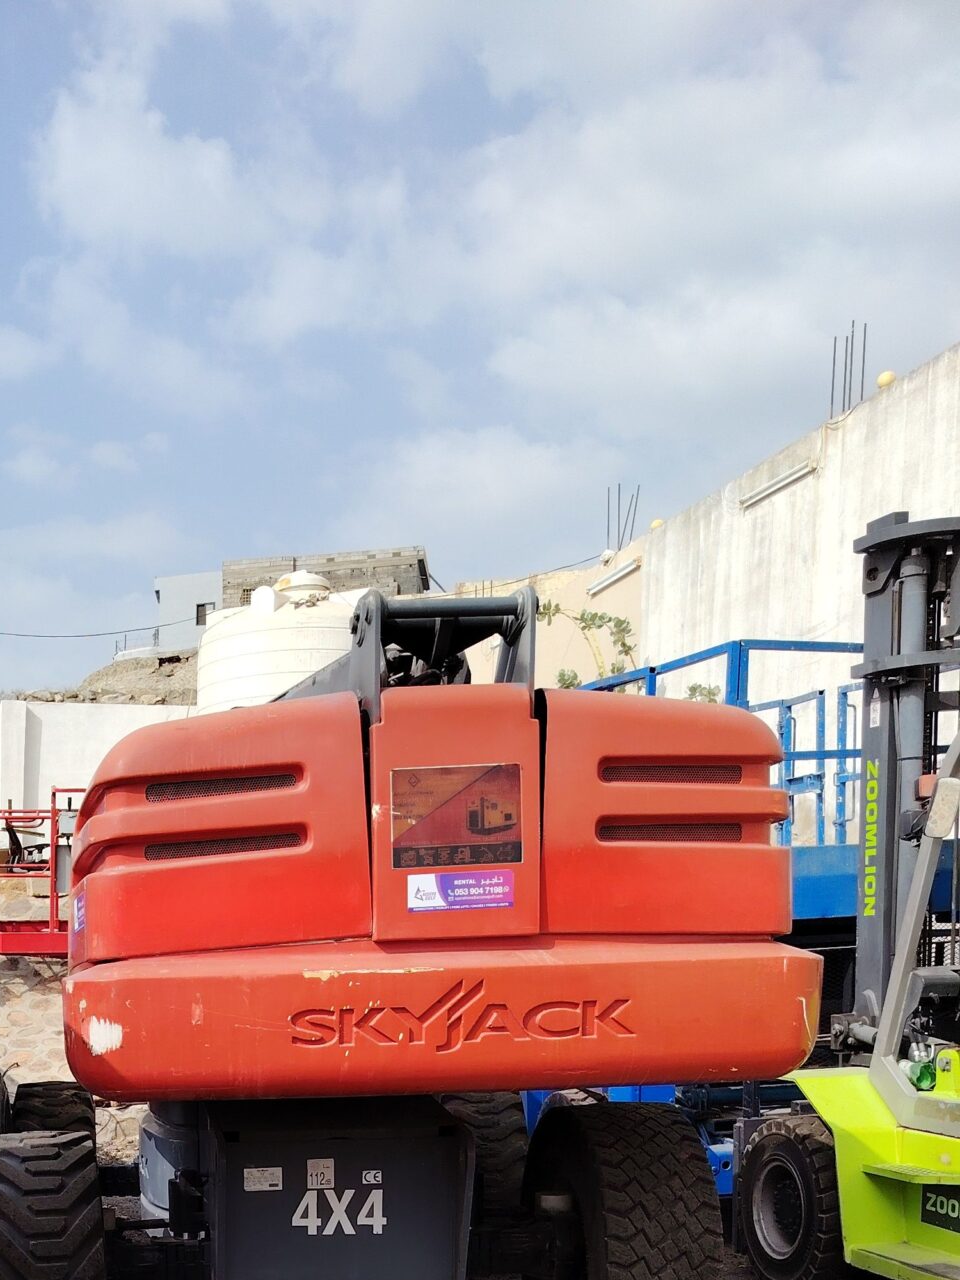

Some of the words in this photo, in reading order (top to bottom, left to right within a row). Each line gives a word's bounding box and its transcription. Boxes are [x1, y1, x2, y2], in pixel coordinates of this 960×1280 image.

[863, 760, 879, 916] ZOOMLION
[454, 888, 469, 896] 053
[469, 887, 484, 895] 904
[485, 886, 503, 894] 7198
[290, 978, 637, 1054] SKYJACK
[363, 1171, 381, 1183] CE
[291, 1189, 388, 1235] 4X4
[925, 1192, 960, 1219] ZOO
